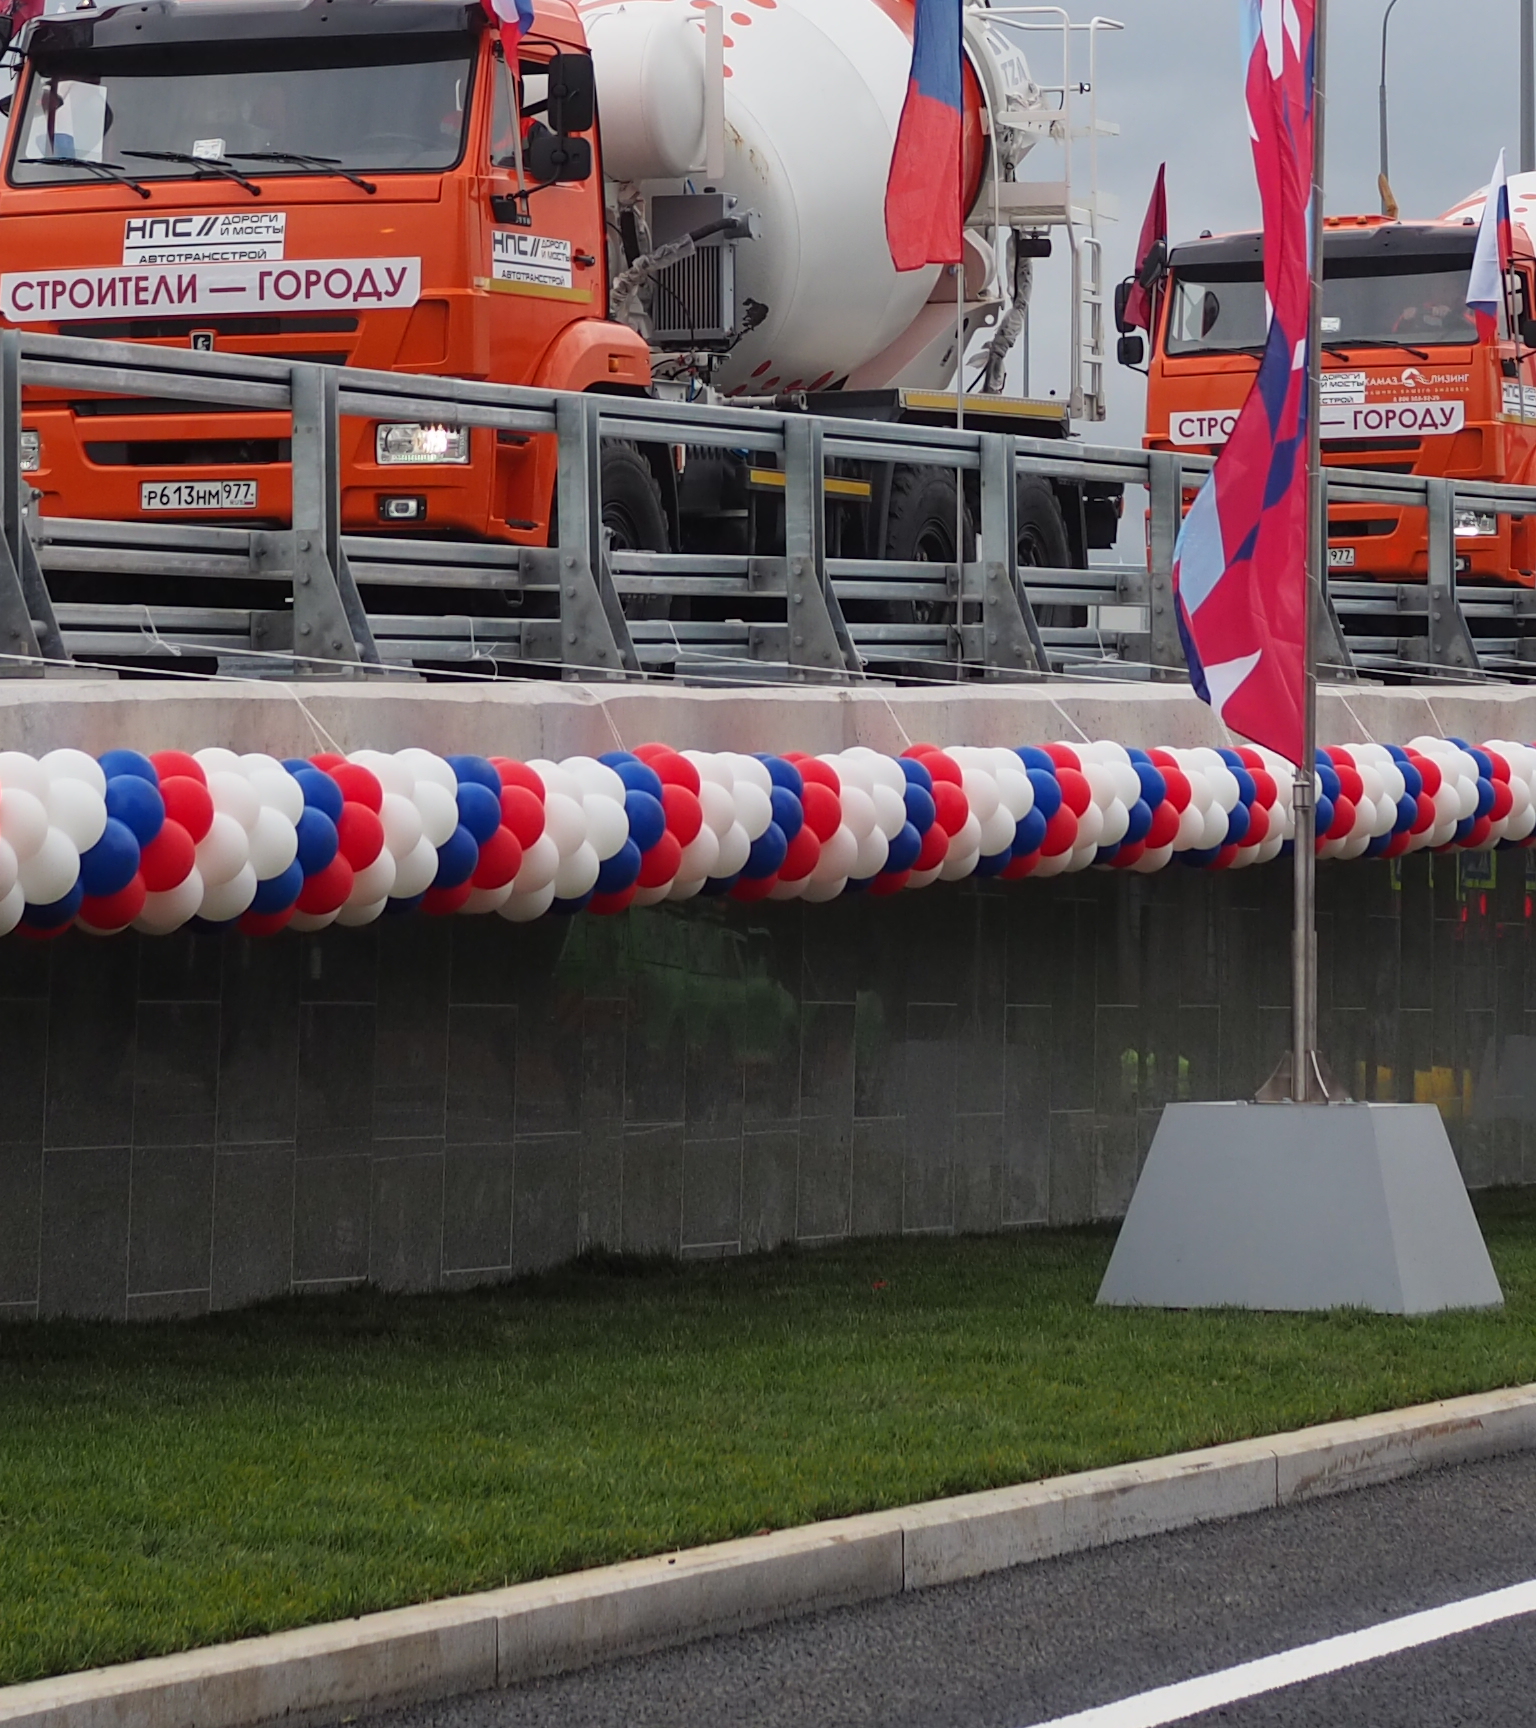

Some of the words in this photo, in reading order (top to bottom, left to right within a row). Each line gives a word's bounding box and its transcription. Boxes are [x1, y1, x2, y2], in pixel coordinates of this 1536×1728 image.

[220, 215, 279, 227] ДОРОГИ
[220, 227, 230, 236] И
[232, 225, 284, 236] МОСТЫ
[541, 239, 568, 251] ДОРОГИ
[139, 249, 268, 264] АВТОТРАНССТРОЙ
[11, 274, 198, 312] СТРОИТЕЛИ
[259, 267, 408, 303] ГОРОДУ
[1321, 373, 1361, 381] ДОРОГИ
[1431, 373, 1469, 384] ЛИЗИНГ
[1329, 380, 1364, 388] МОСТЫ
[1179, 416, 1237, 438] СТРО
[1354, 407, 1455, 430] ГОРОДУ
[224, 483, 251, 499] 977
[1331, 549, 1350, 561] 977
